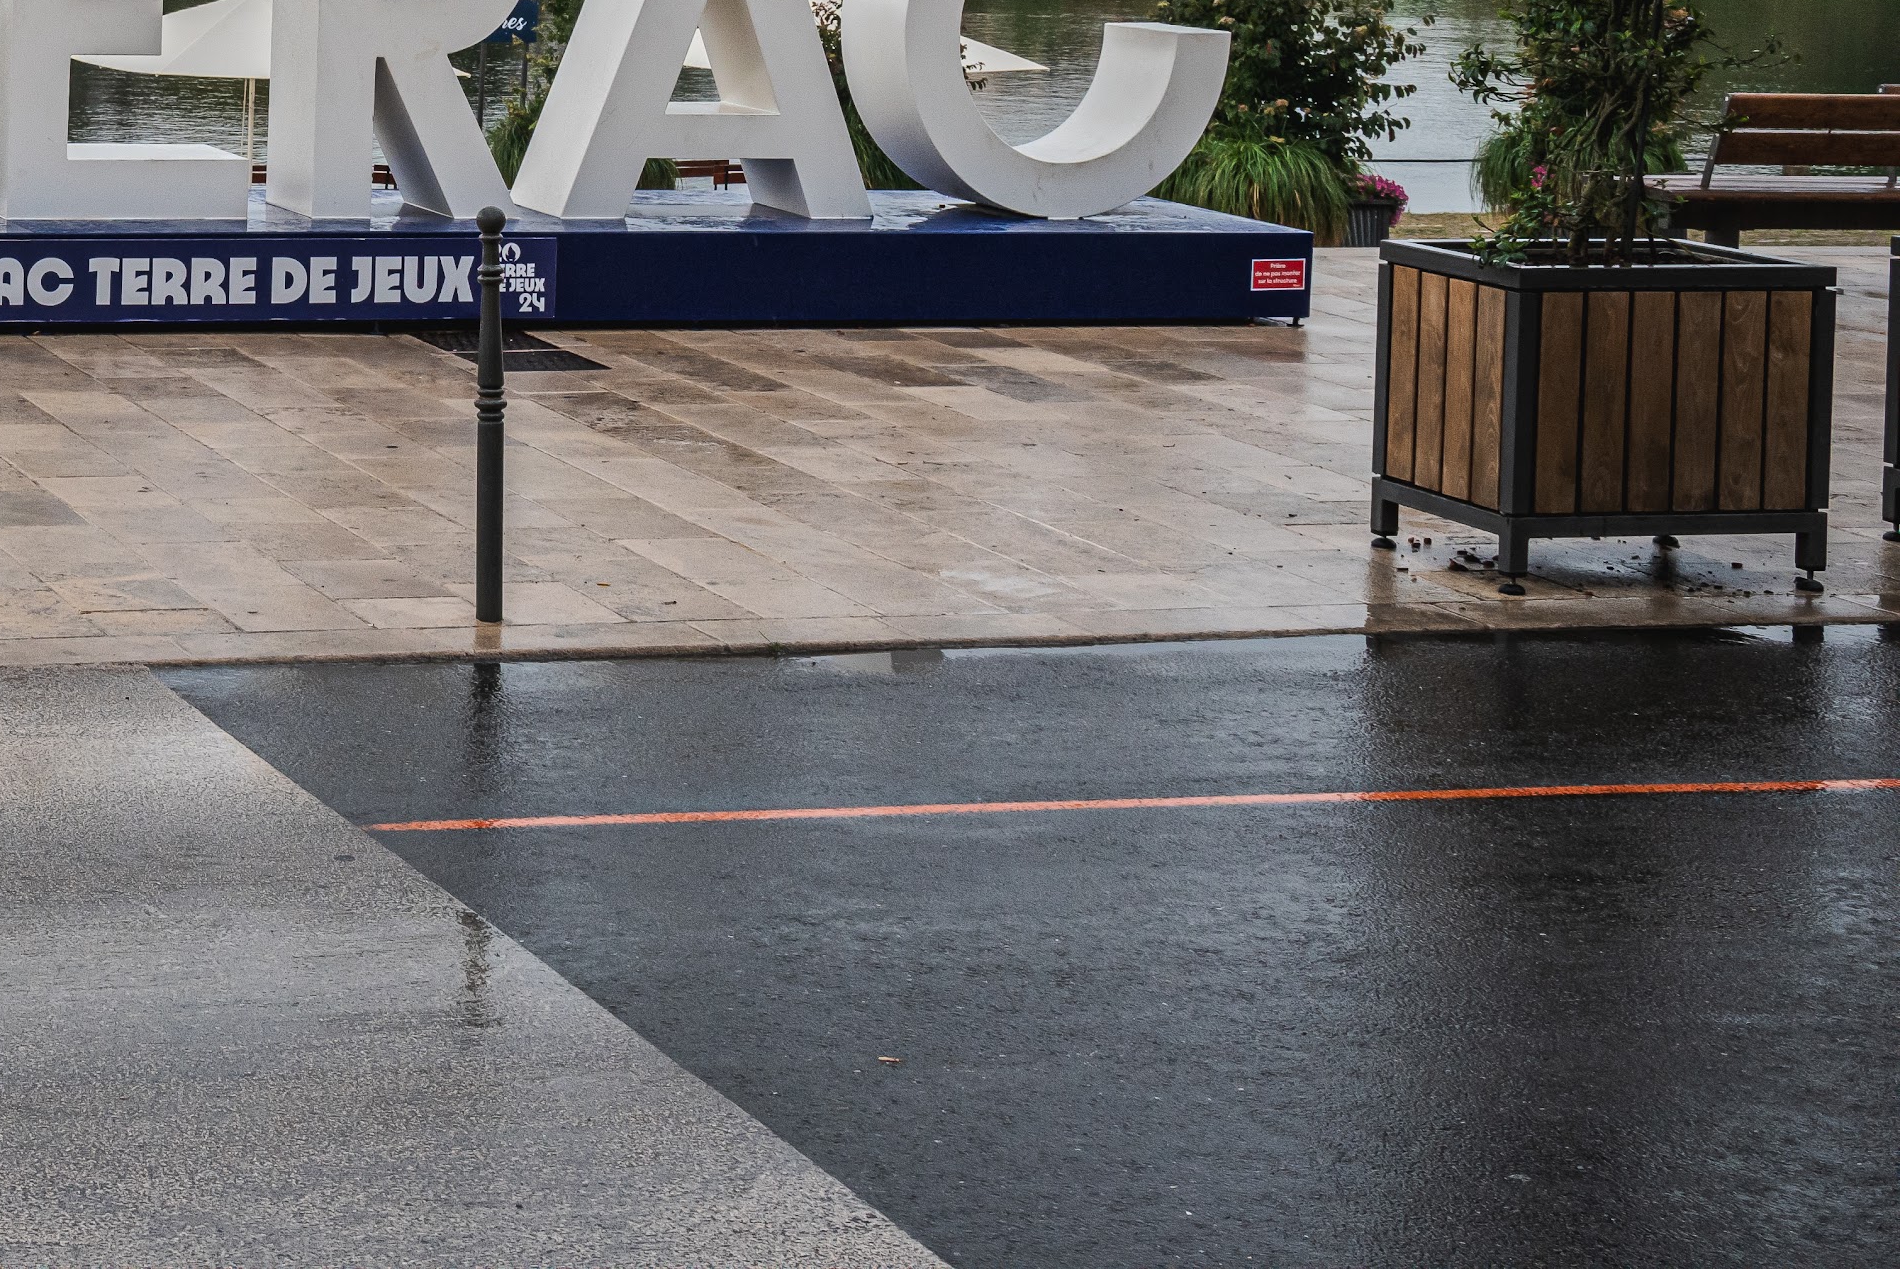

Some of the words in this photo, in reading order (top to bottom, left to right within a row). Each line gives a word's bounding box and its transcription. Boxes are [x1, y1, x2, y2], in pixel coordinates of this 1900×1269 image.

[88, 257, 257, 306] TERRE
[271, 256, 337, 304] DE
[351, 255, 474, 303] JEUX
[509, 278, 545, 292] JEUX
[519, 292, 545, 312] 24
